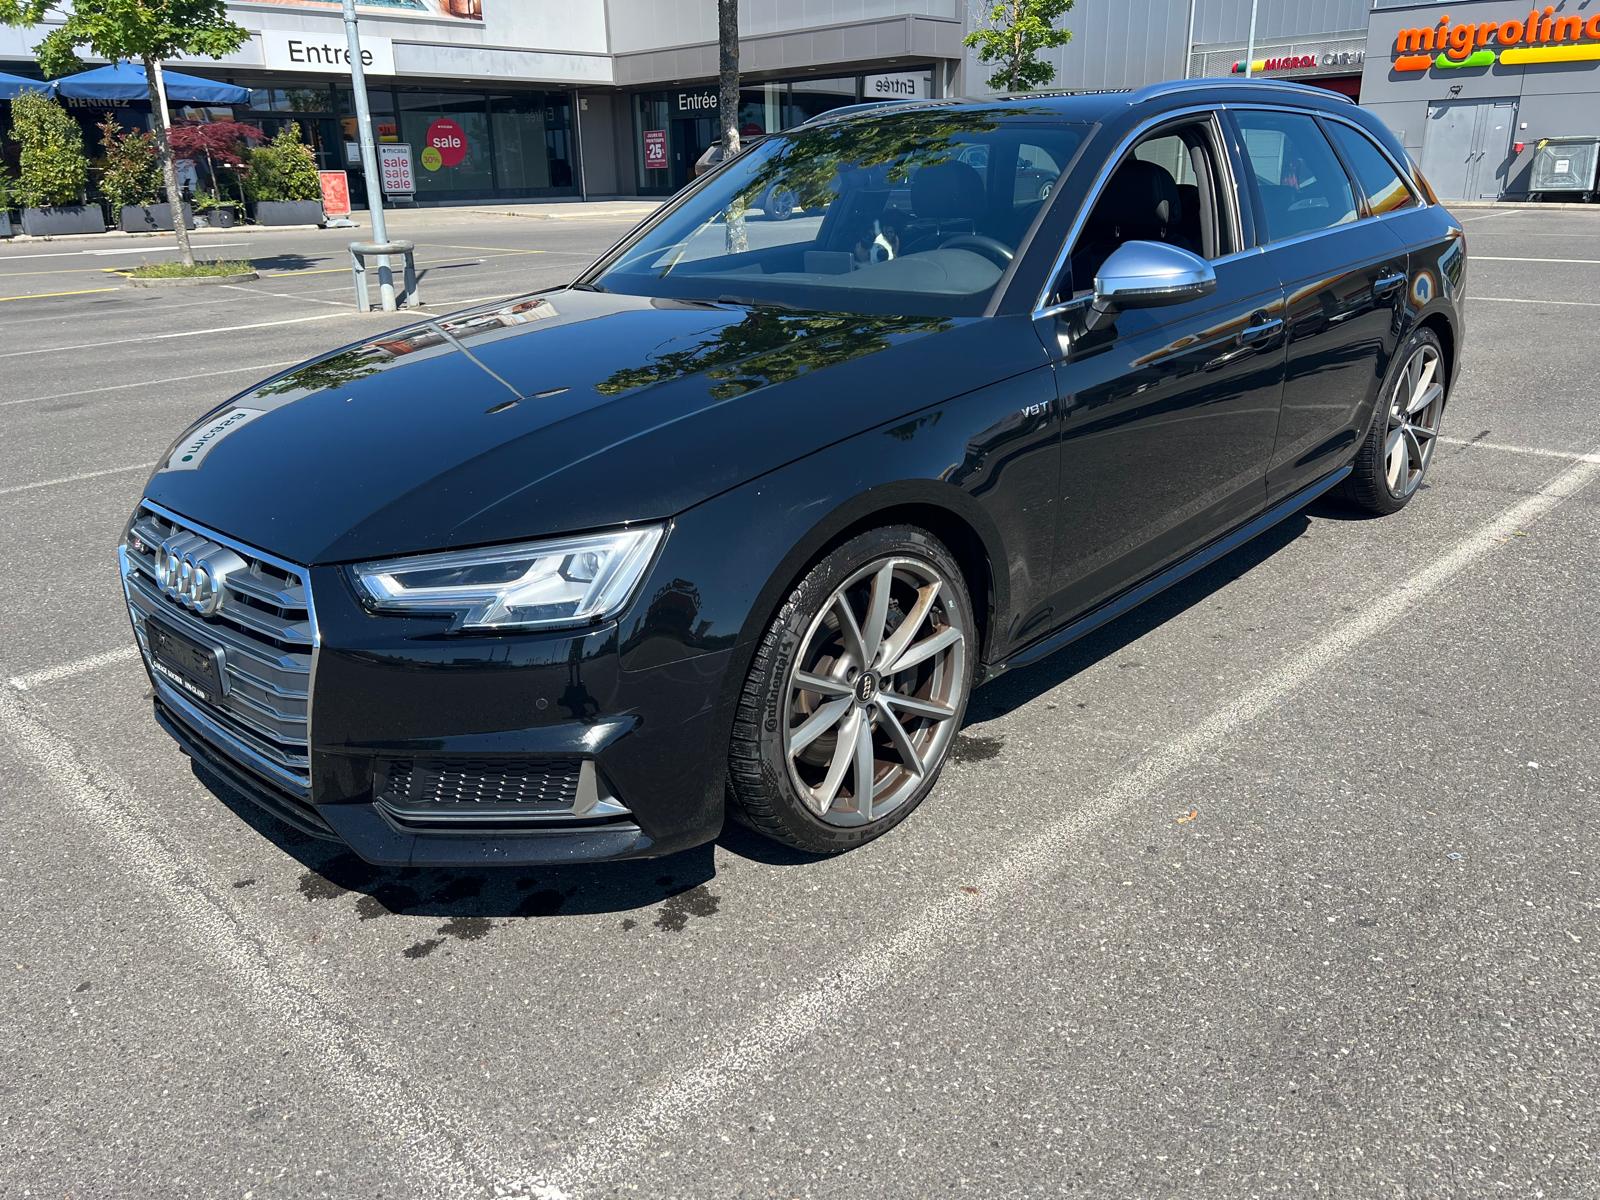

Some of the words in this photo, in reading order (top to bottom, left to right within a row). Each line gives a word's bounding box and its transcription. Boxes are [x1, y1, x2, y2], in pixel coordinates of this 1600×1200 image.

[1396, 5, 1600, 59] migrolino
[1263, 55, 1317, 71] MIGROL
[68, 97, 130, 108] HENNIEZ
[678, 91, 717, 110] Entrée
[432, 135, 461, 148] sale
[383, 156, 409, 168] sale
[384, 167, 410, 179] sale
[386, 178, 411, 189] sale
